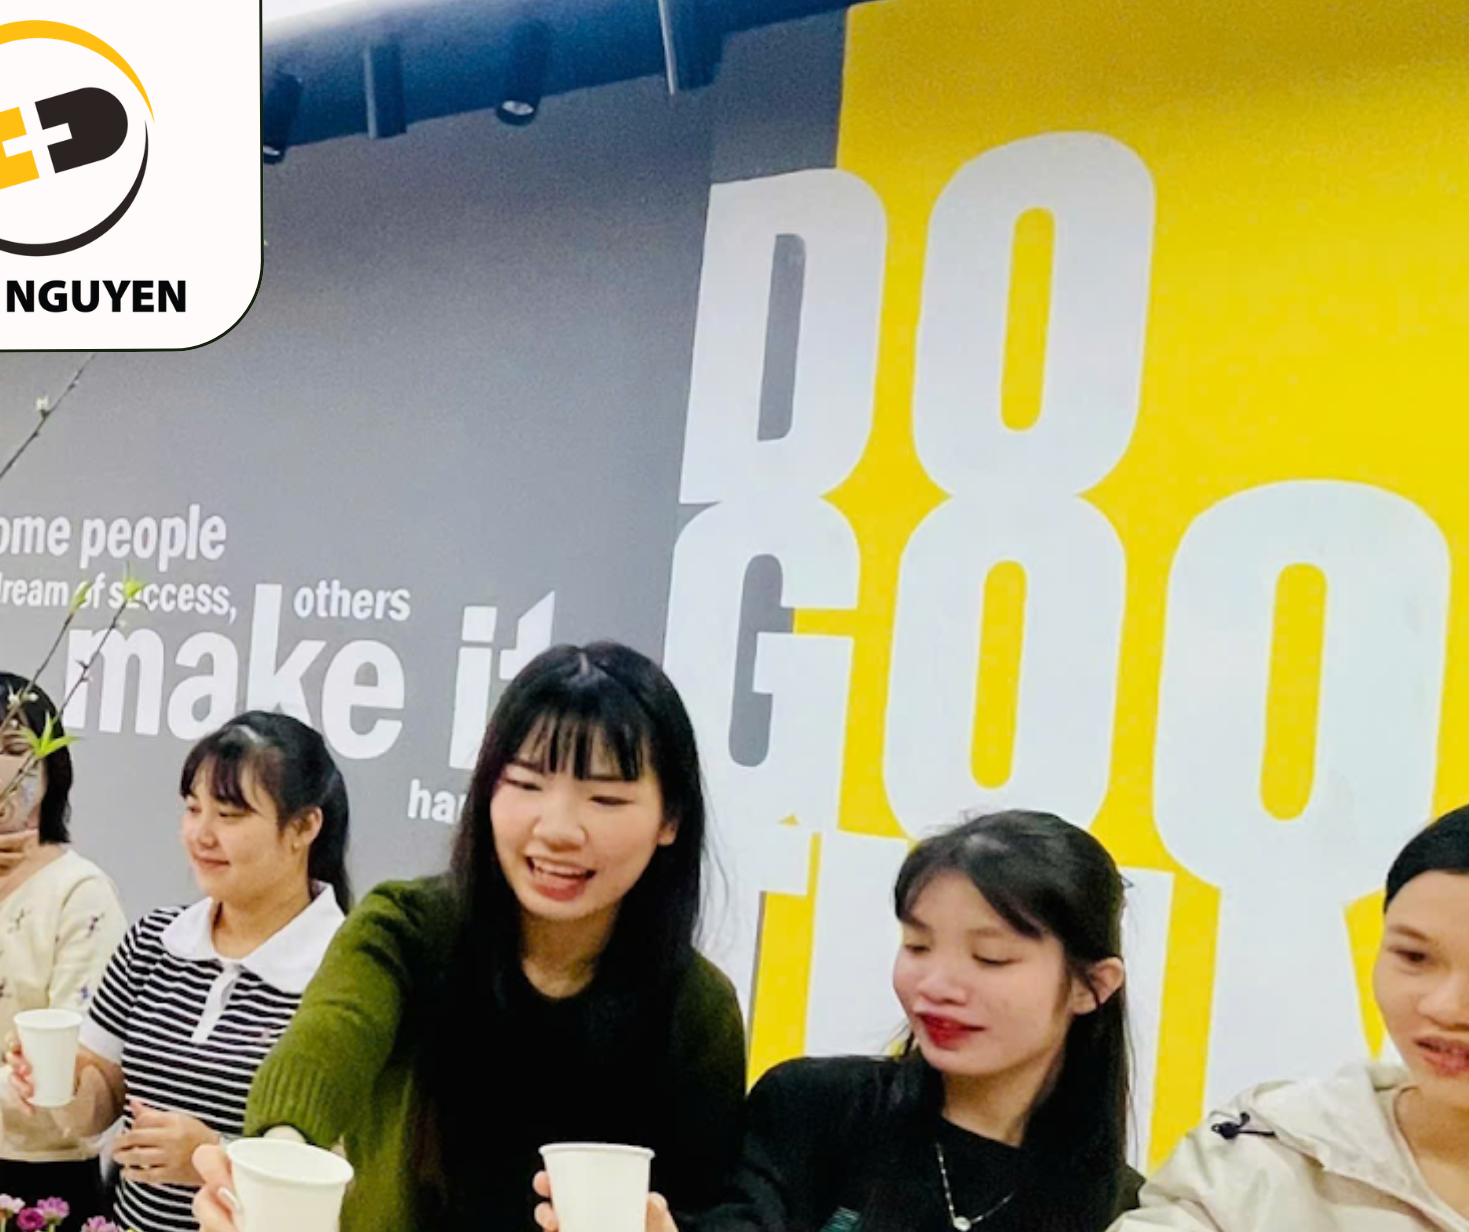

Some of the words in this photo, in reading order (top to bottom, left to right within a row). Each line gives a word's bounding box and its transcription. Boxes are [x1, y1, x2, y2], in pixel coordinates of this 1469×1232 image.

[679, 130, 1156, 503] DO
[79, 503, 227, 572] people
[293, 579, 412, 621] others
[62, 583, 406, 760] make
